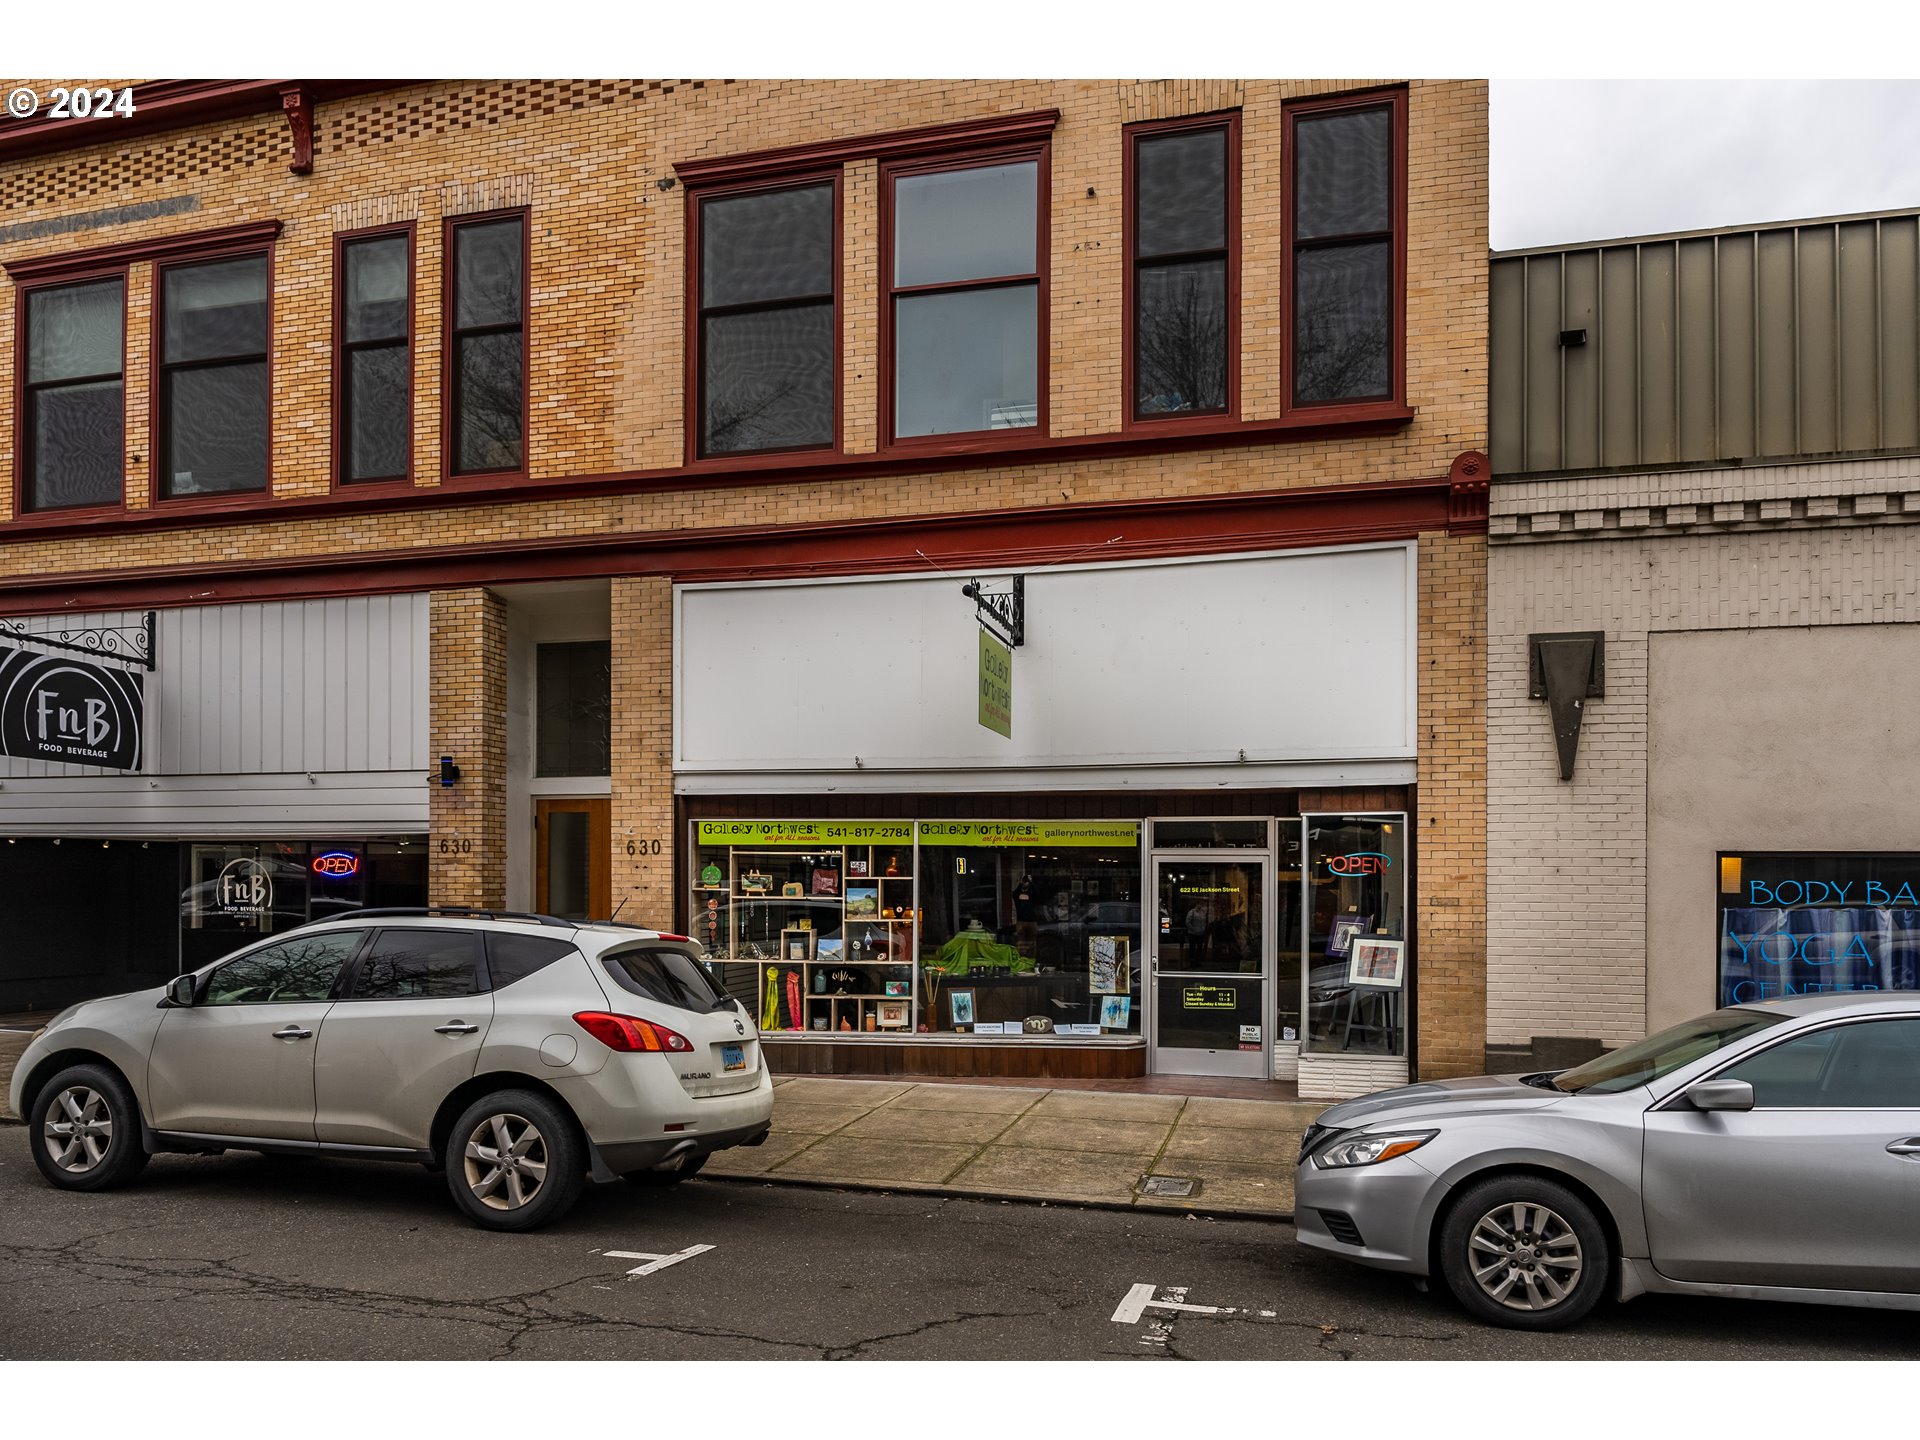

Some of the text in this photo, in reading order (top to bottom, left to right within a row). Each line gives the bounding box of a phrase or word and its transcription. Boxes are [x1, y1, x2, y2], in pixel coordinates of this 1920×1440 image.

[37, 690, 110, 746] FnB
[38, 743, 108, 758] FOOD BEVERAGE
[827, 827, 911, 838] 541-817-2784
[1044, 829, 1135, 838] gallerynorthwest.net
[440, 838, 471, 854] 630
[626, 839, 661, 856] 630
[313, 857, 358, 873] OPEN
[1331, 856, 1387, 875] OPEN
[223, 875, 266, 905] FnB
[1750, 880, 1853, 905] BODY
[1729, 931, 1874, 967] YOGA
[680, 1072, 711, 1080] MURANO
